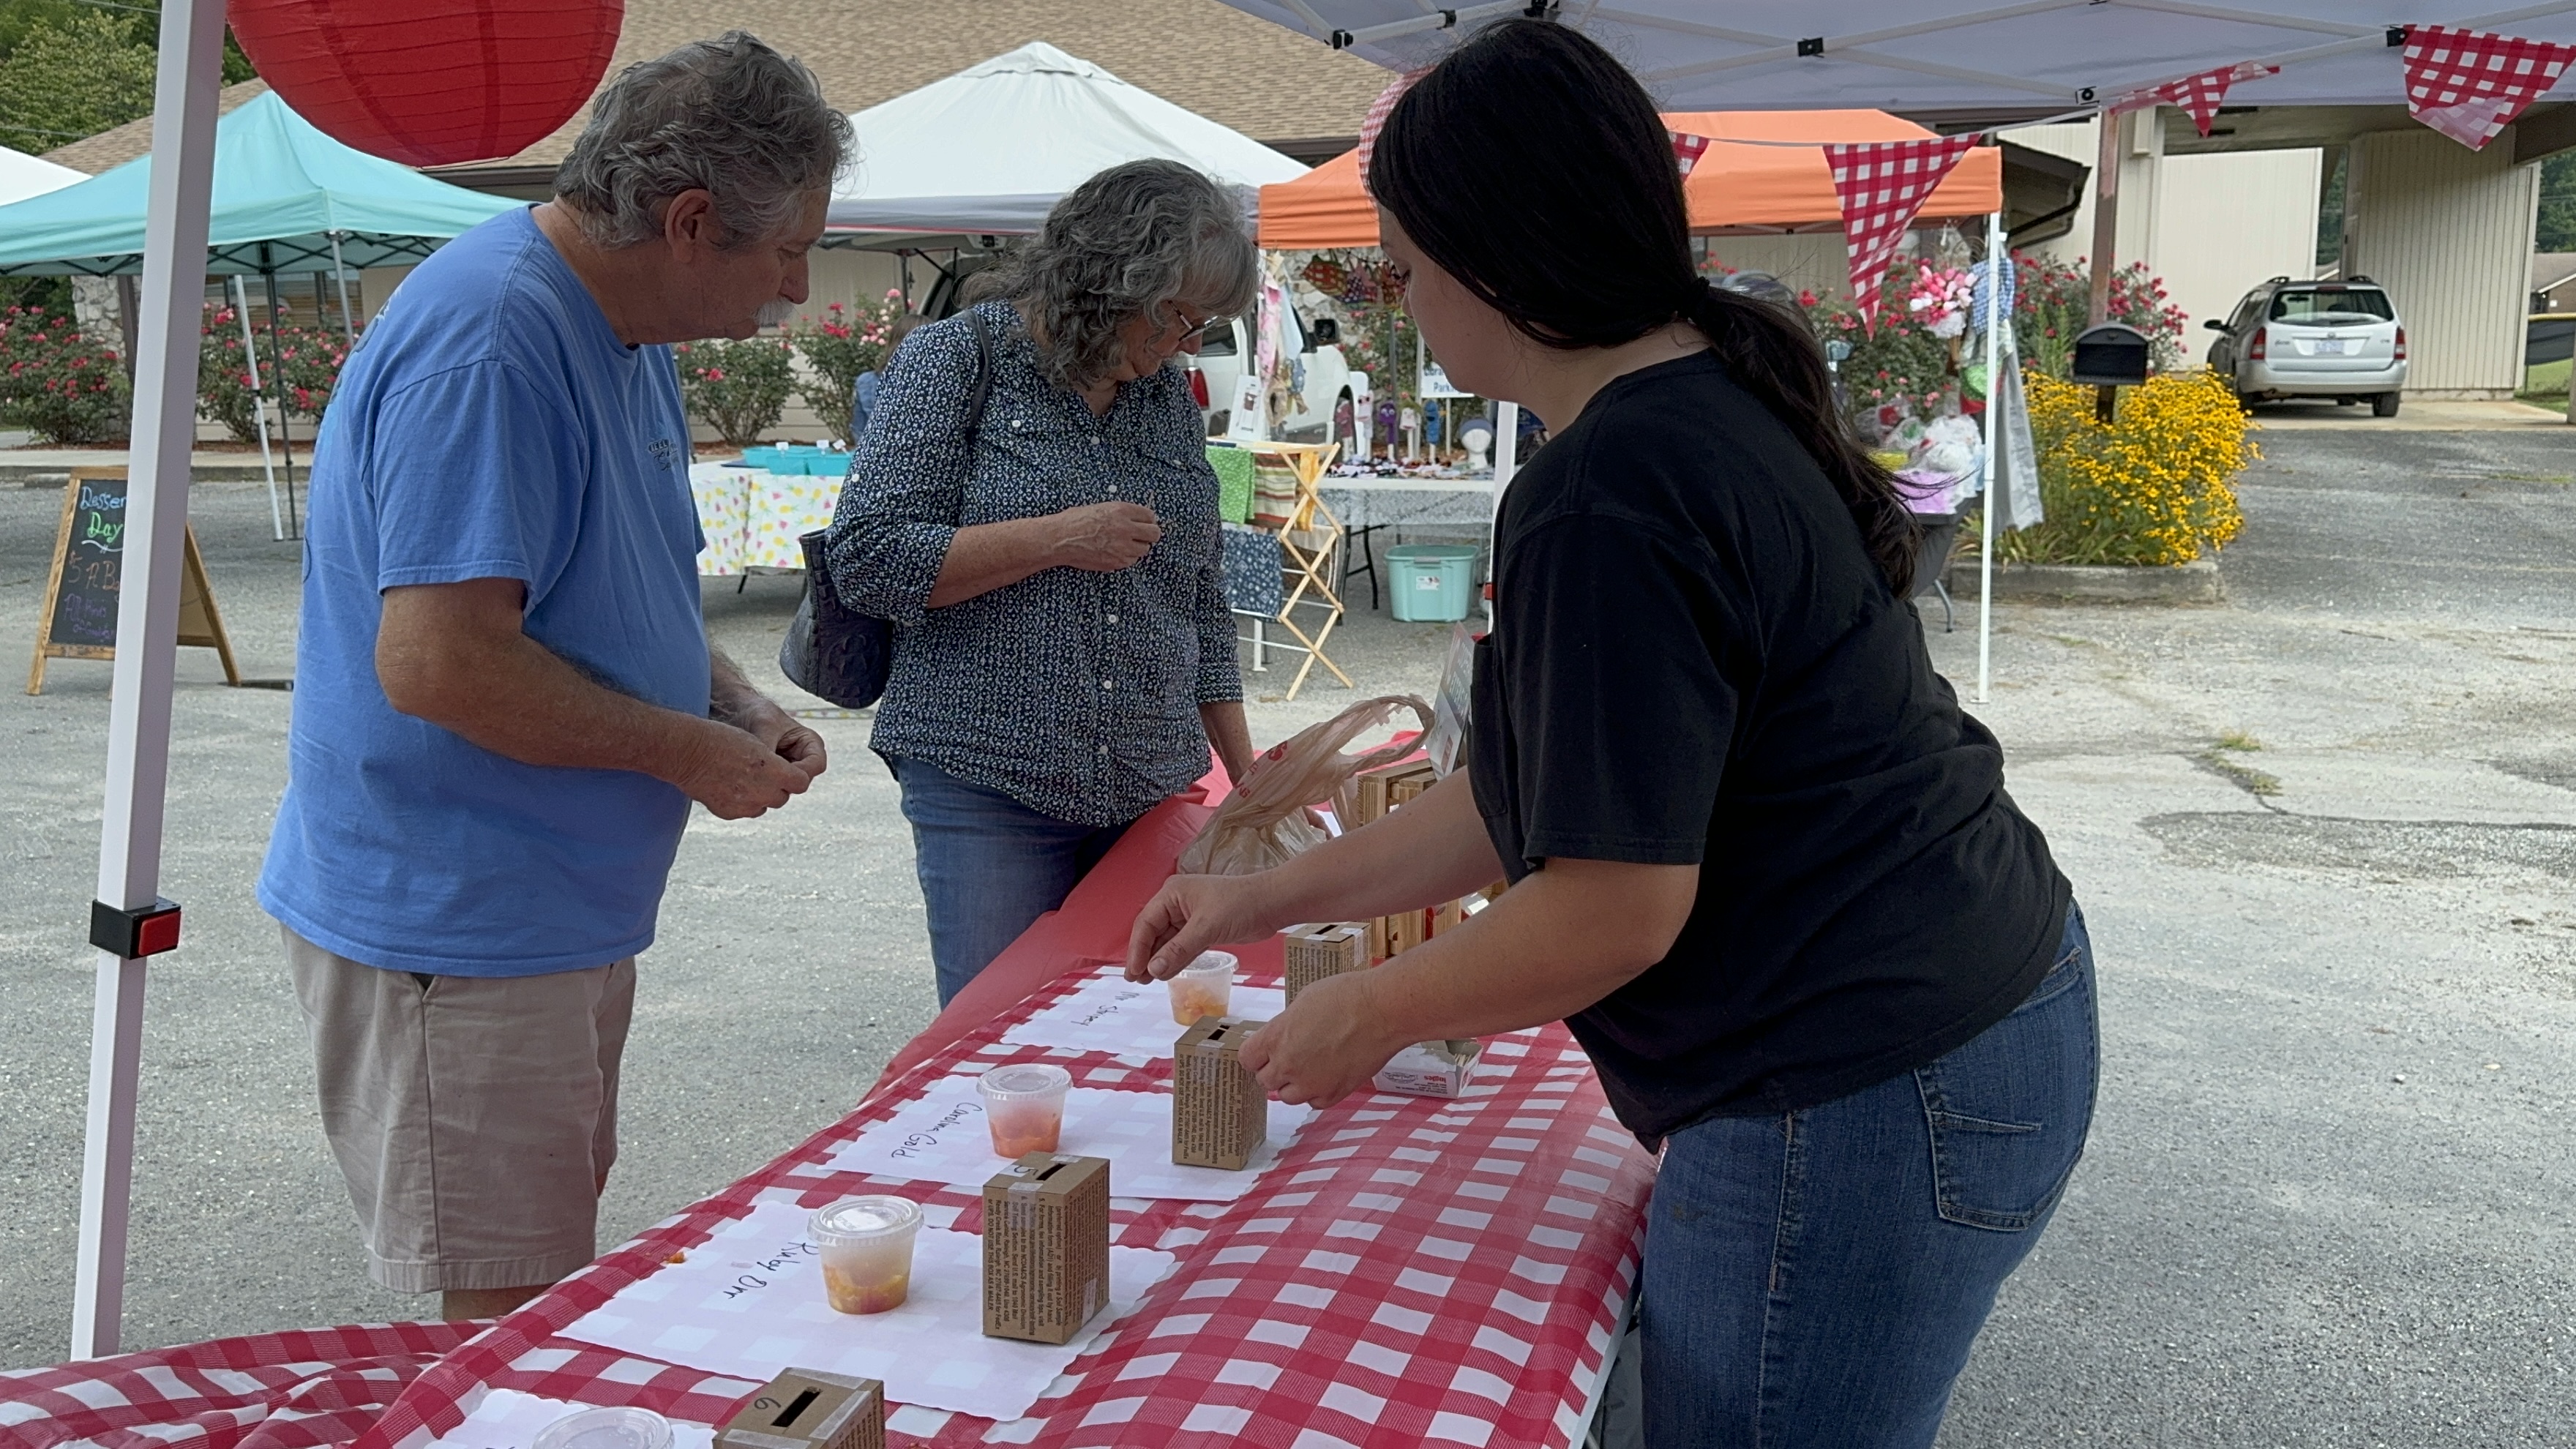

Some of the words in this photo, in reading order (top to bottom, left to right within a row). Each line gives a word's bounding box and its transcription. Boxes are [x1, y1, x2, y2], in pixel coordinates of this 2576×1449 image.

[80, 486, 127, 510] Desser
[87, 512, 123, 543] Day
[86, 561, 99, 589] A
[926, 1102, 982, 1132] Carolina
[891, 1133, 937, 1158] Gold
[1014, 1165, 1039, 1176] 5
[988, 1218, 994, 1227] DO
[723, 1275, 767, 1300] Orr
